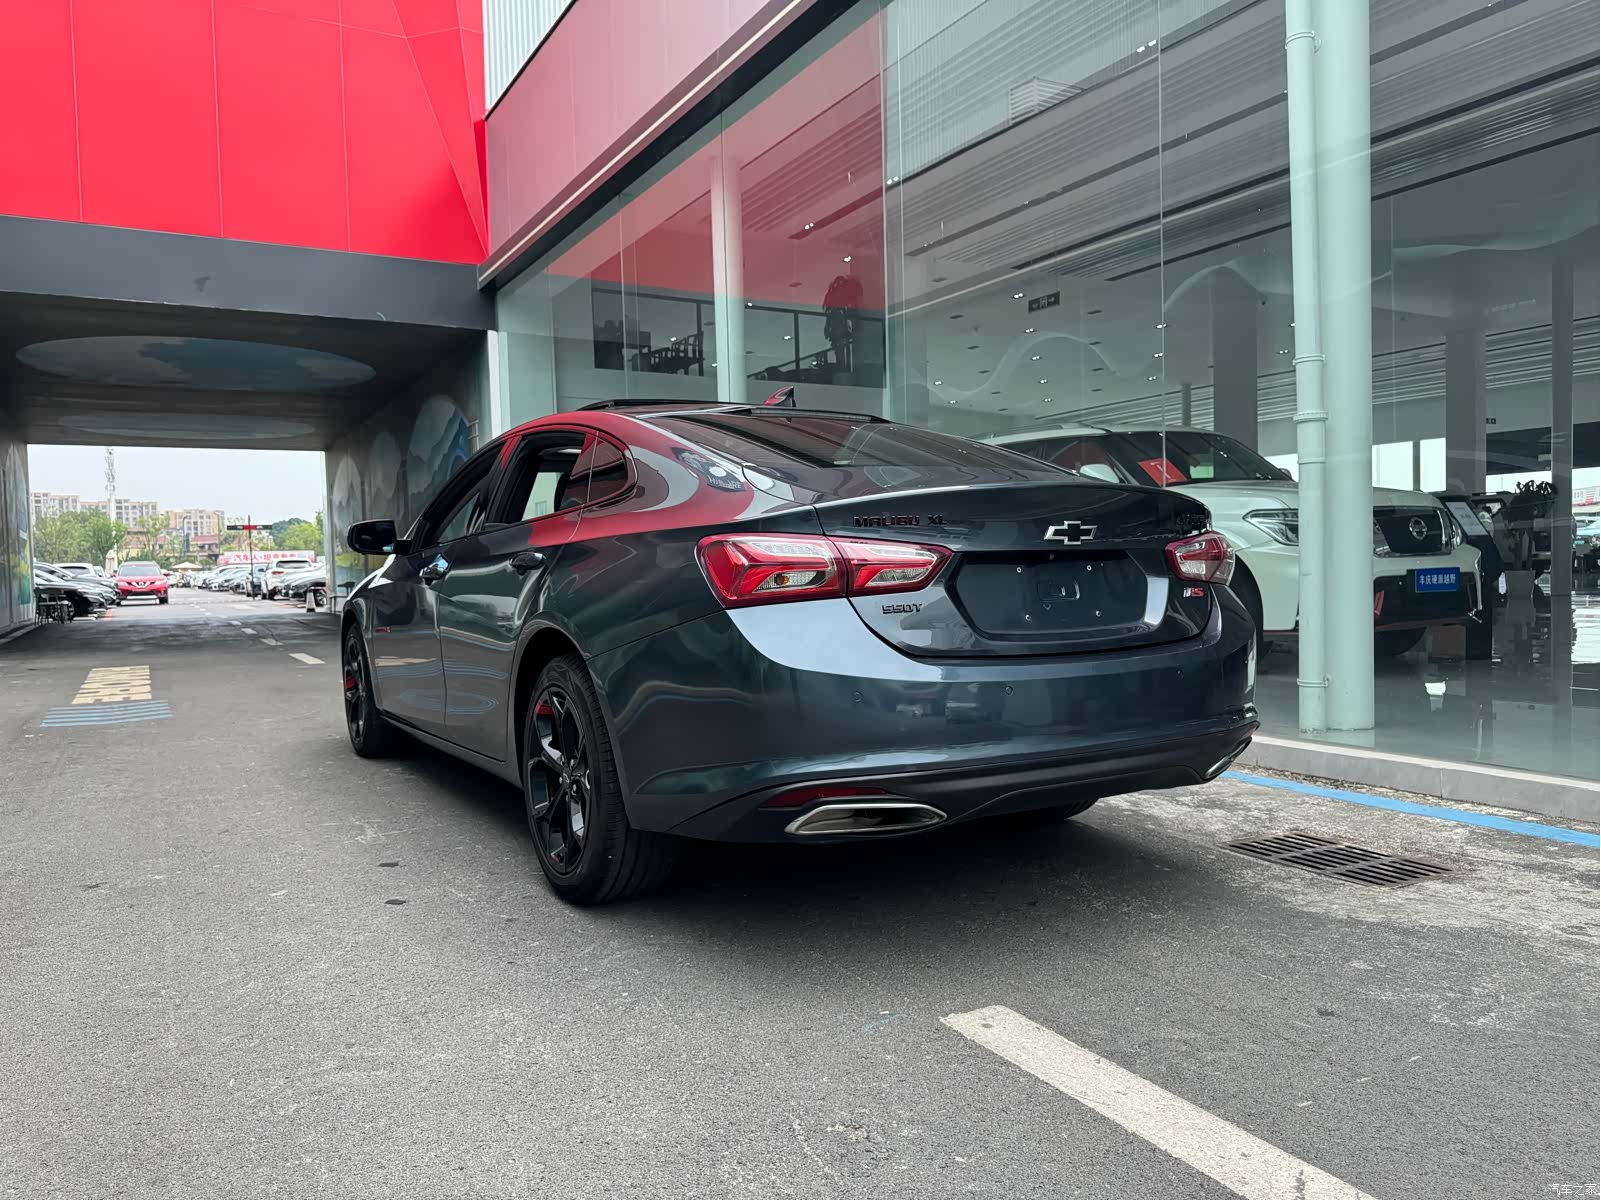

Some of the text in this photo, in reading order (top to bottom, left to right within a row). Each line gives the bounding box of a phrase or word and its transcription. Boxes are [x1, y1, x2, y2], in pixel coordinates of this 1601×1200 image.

[853, 514, 948, 527] MALIBU XL
[881, 603, 923, 615] 550T
